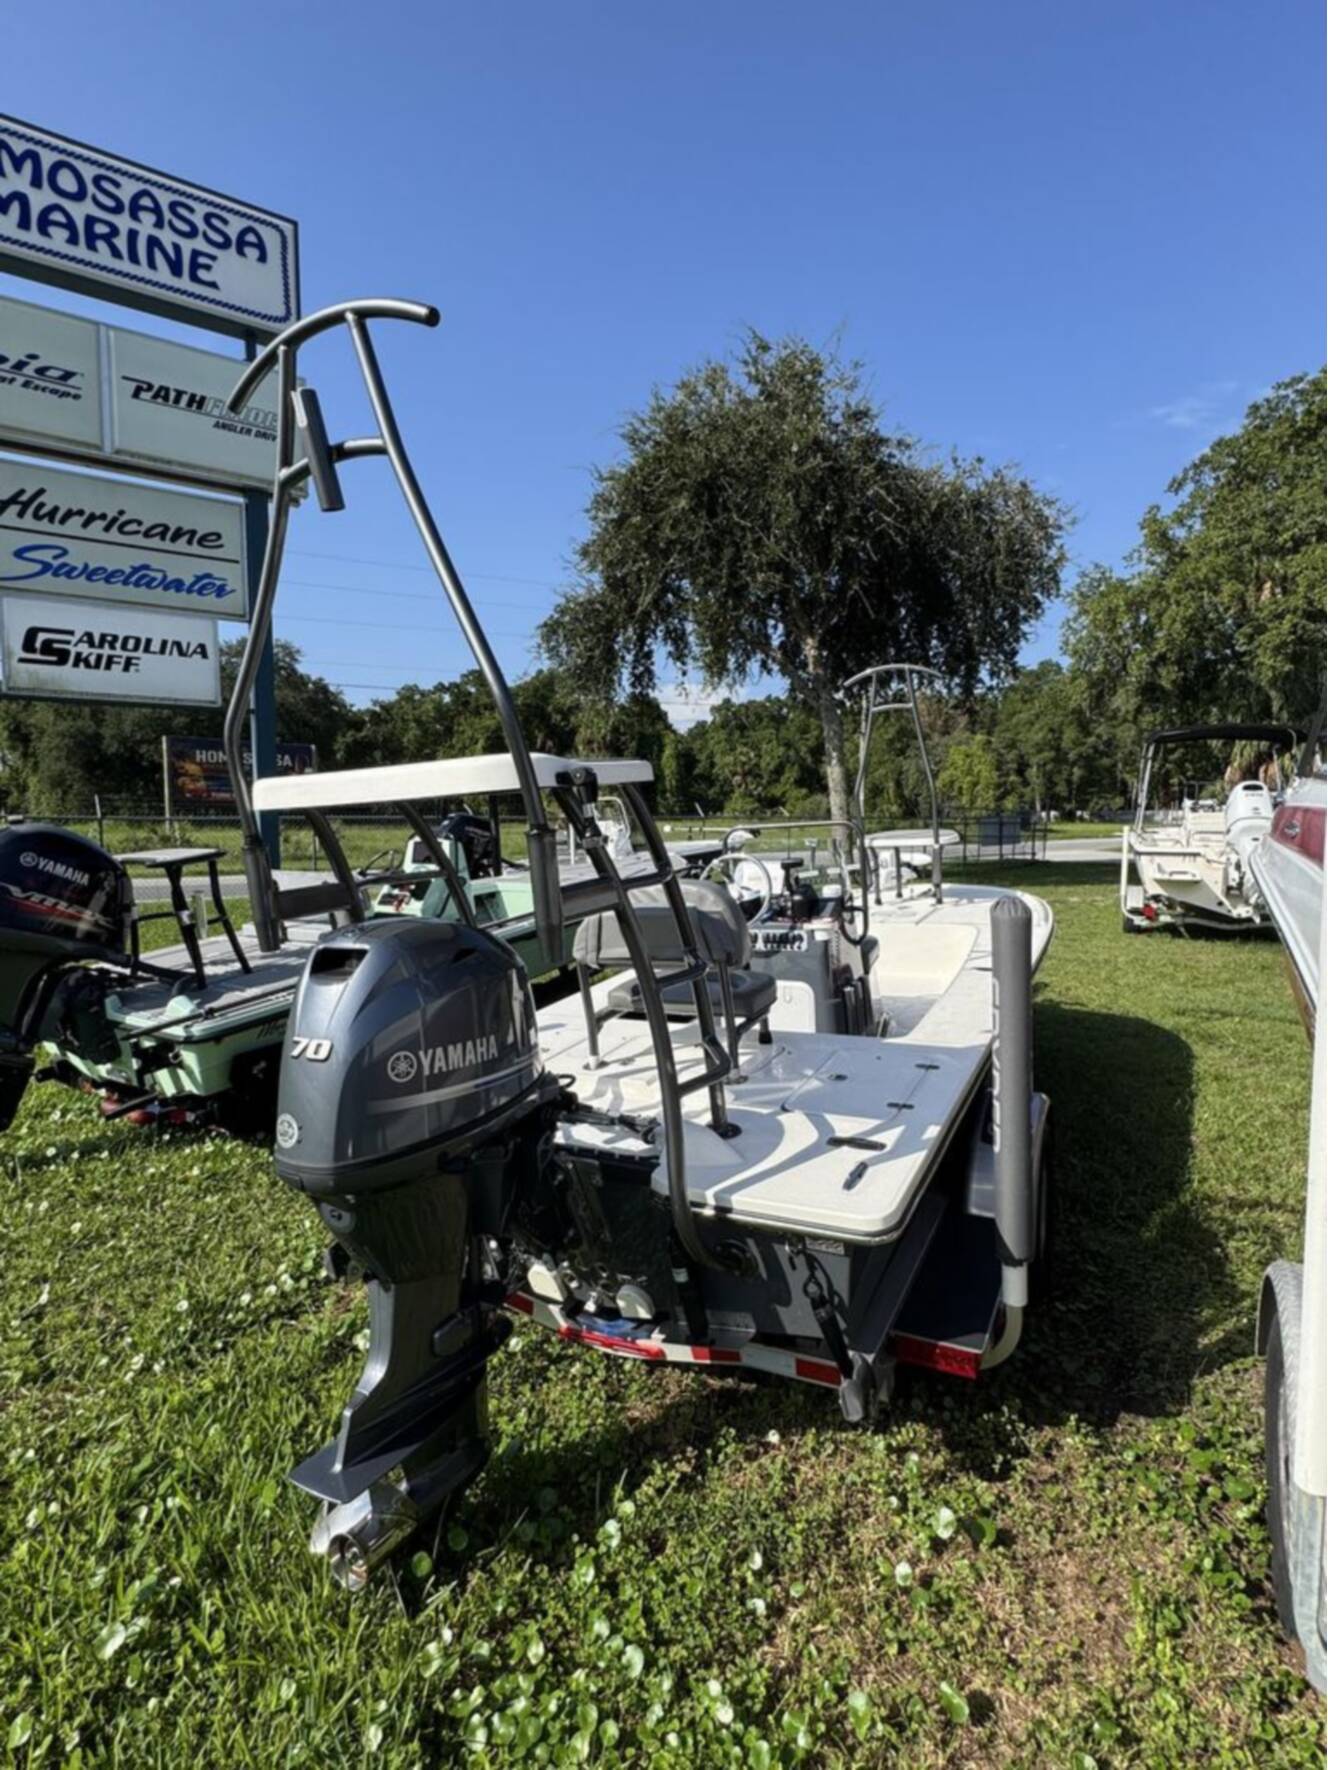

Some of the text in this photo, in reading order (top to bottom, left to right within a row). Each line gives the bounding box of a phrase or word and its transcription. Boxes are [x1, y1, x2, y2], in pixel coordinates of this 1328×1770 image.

[0, 190, 221, 291] MARINE
[21, 379, 82, 401] Escape
[212, 419, 278, 443] ANGLER DRIV
[0, 487, 225, 550] Hurricane
[0, 543, 237, 599] Sweetwater
[17, 637, 140, 673] SKIFF
[21, 626, 209, 660] CAROLINA
[37, 857, 90, 886] YAMAHA
[290, 1036, 333, 1062] 70
[418, 1034, 499, 1077] YAMAHA
